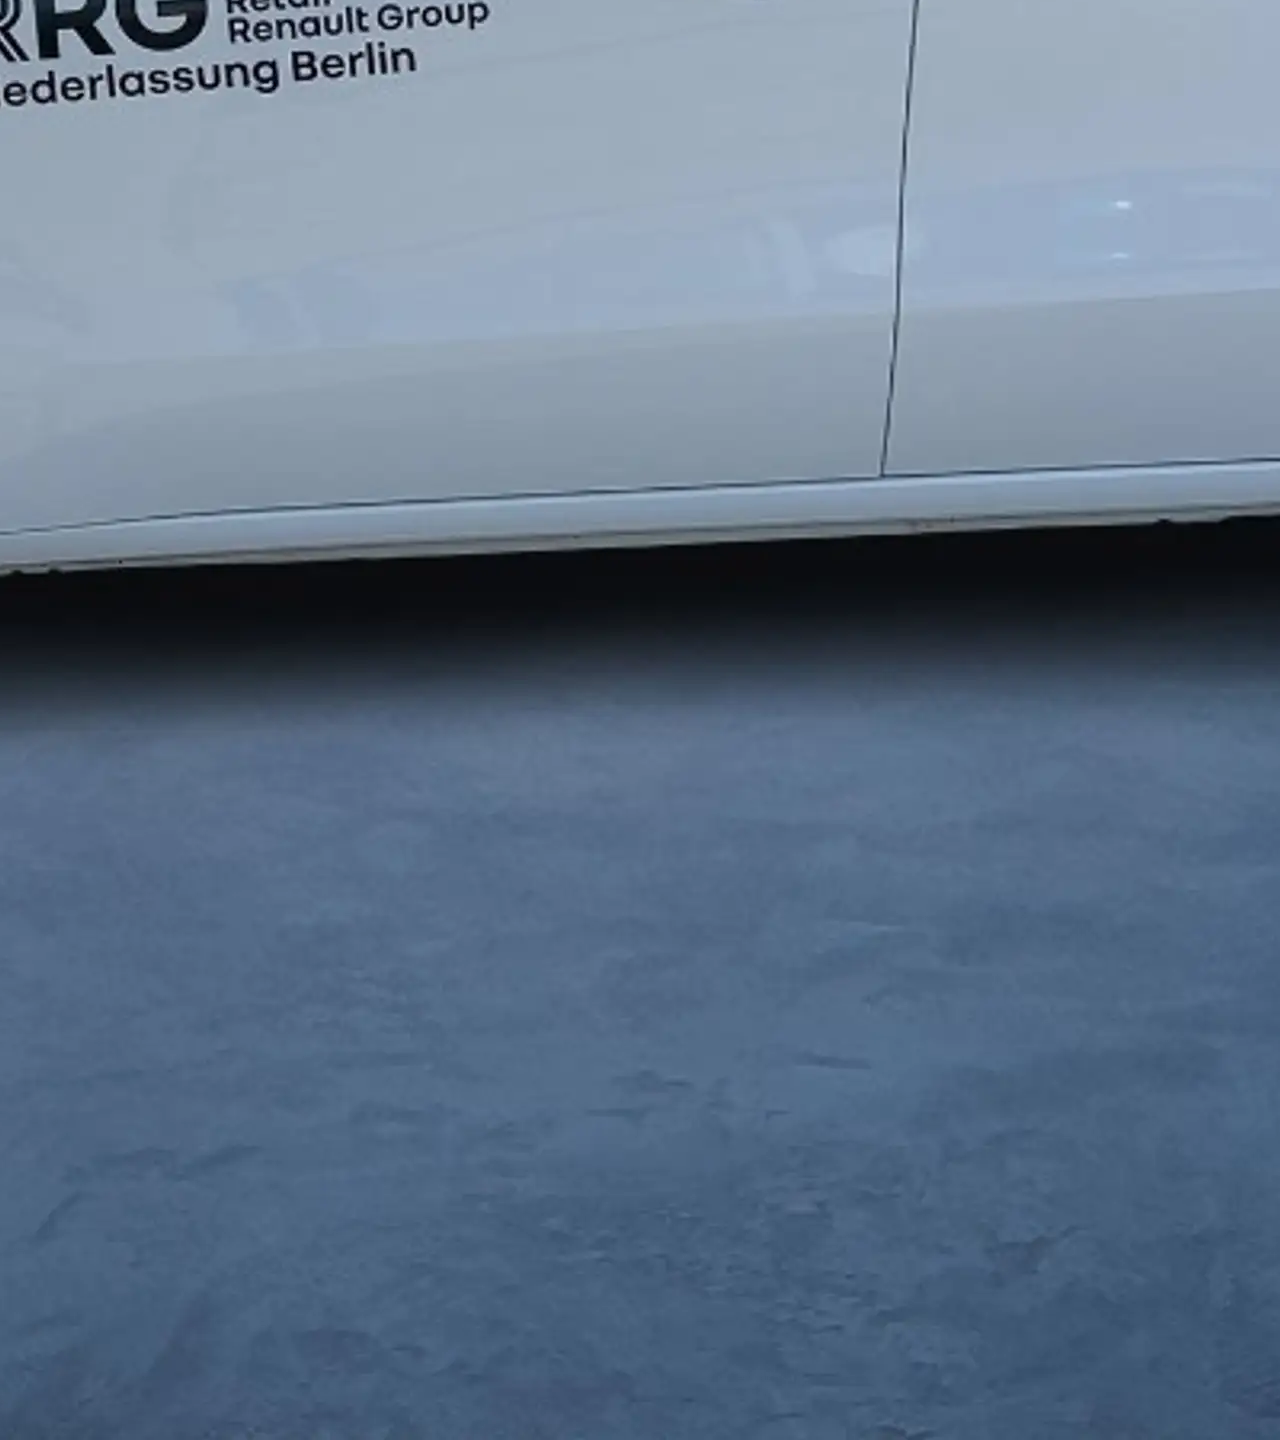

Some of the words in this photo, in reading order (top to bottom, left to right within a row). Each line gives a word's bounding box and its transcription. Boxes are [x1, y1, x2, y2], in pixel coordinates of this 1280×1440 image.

[227, 5, 371, 45] Renault
[376, 0, 491, 32] Group
[290, 41, 418, 83] Berlin
